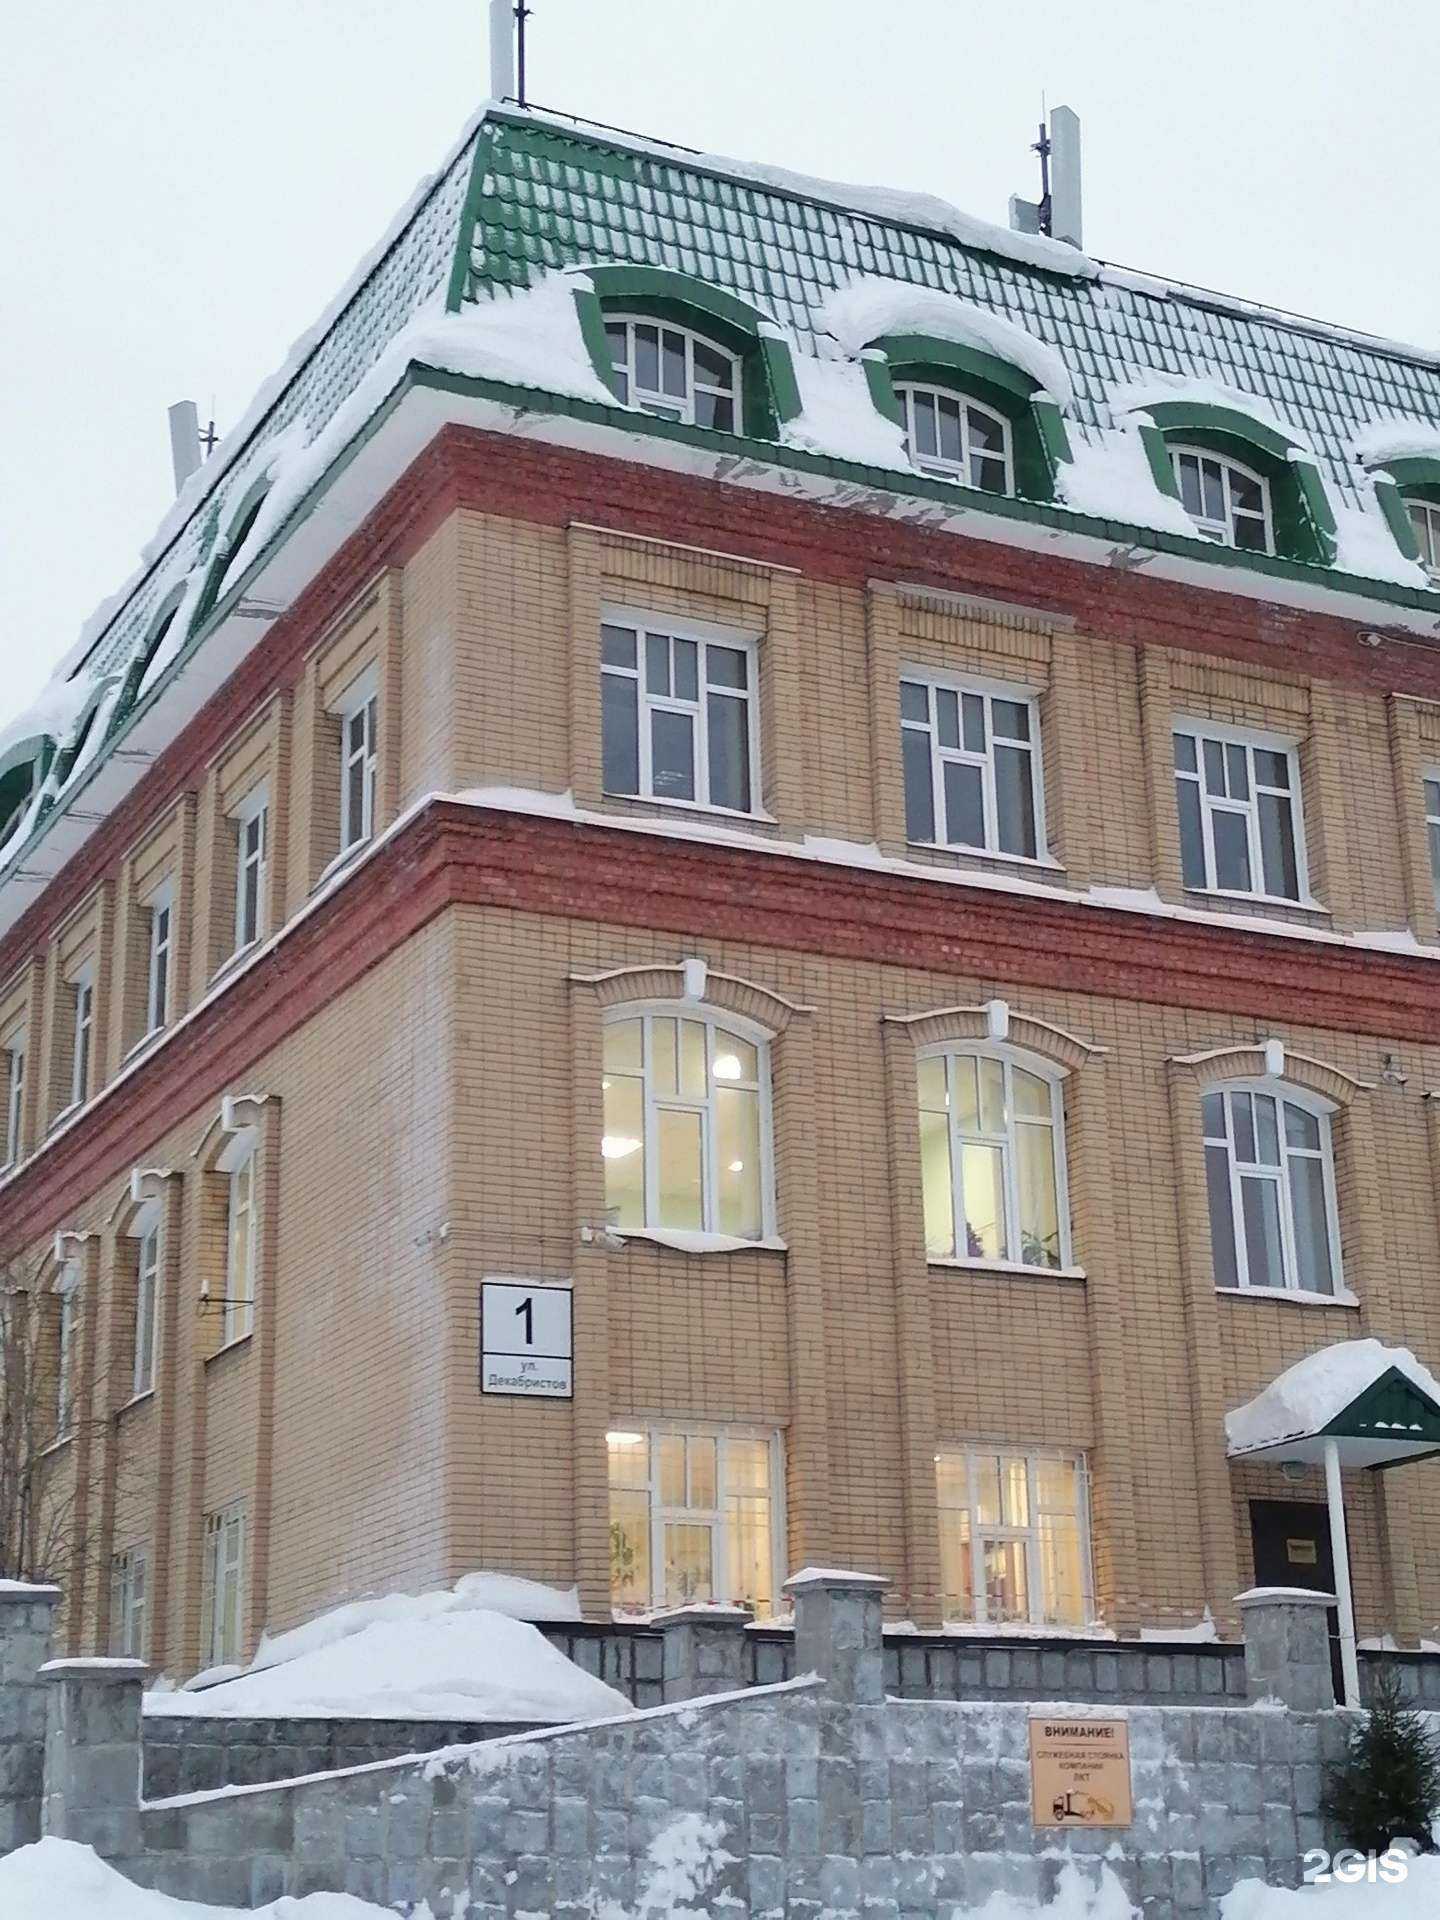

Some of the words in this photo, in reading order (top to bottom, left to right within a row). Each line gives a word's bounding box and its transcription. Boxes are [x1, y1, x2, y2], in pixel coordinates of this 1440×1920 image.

[515, 1297, 533, 1345] 1
[520, 1361, 537, 1373] ул.
[488, 1373, 567, 1390] Декабристов
[1044, 1726, 1115, 1738] ВНИМАНИЕ!
